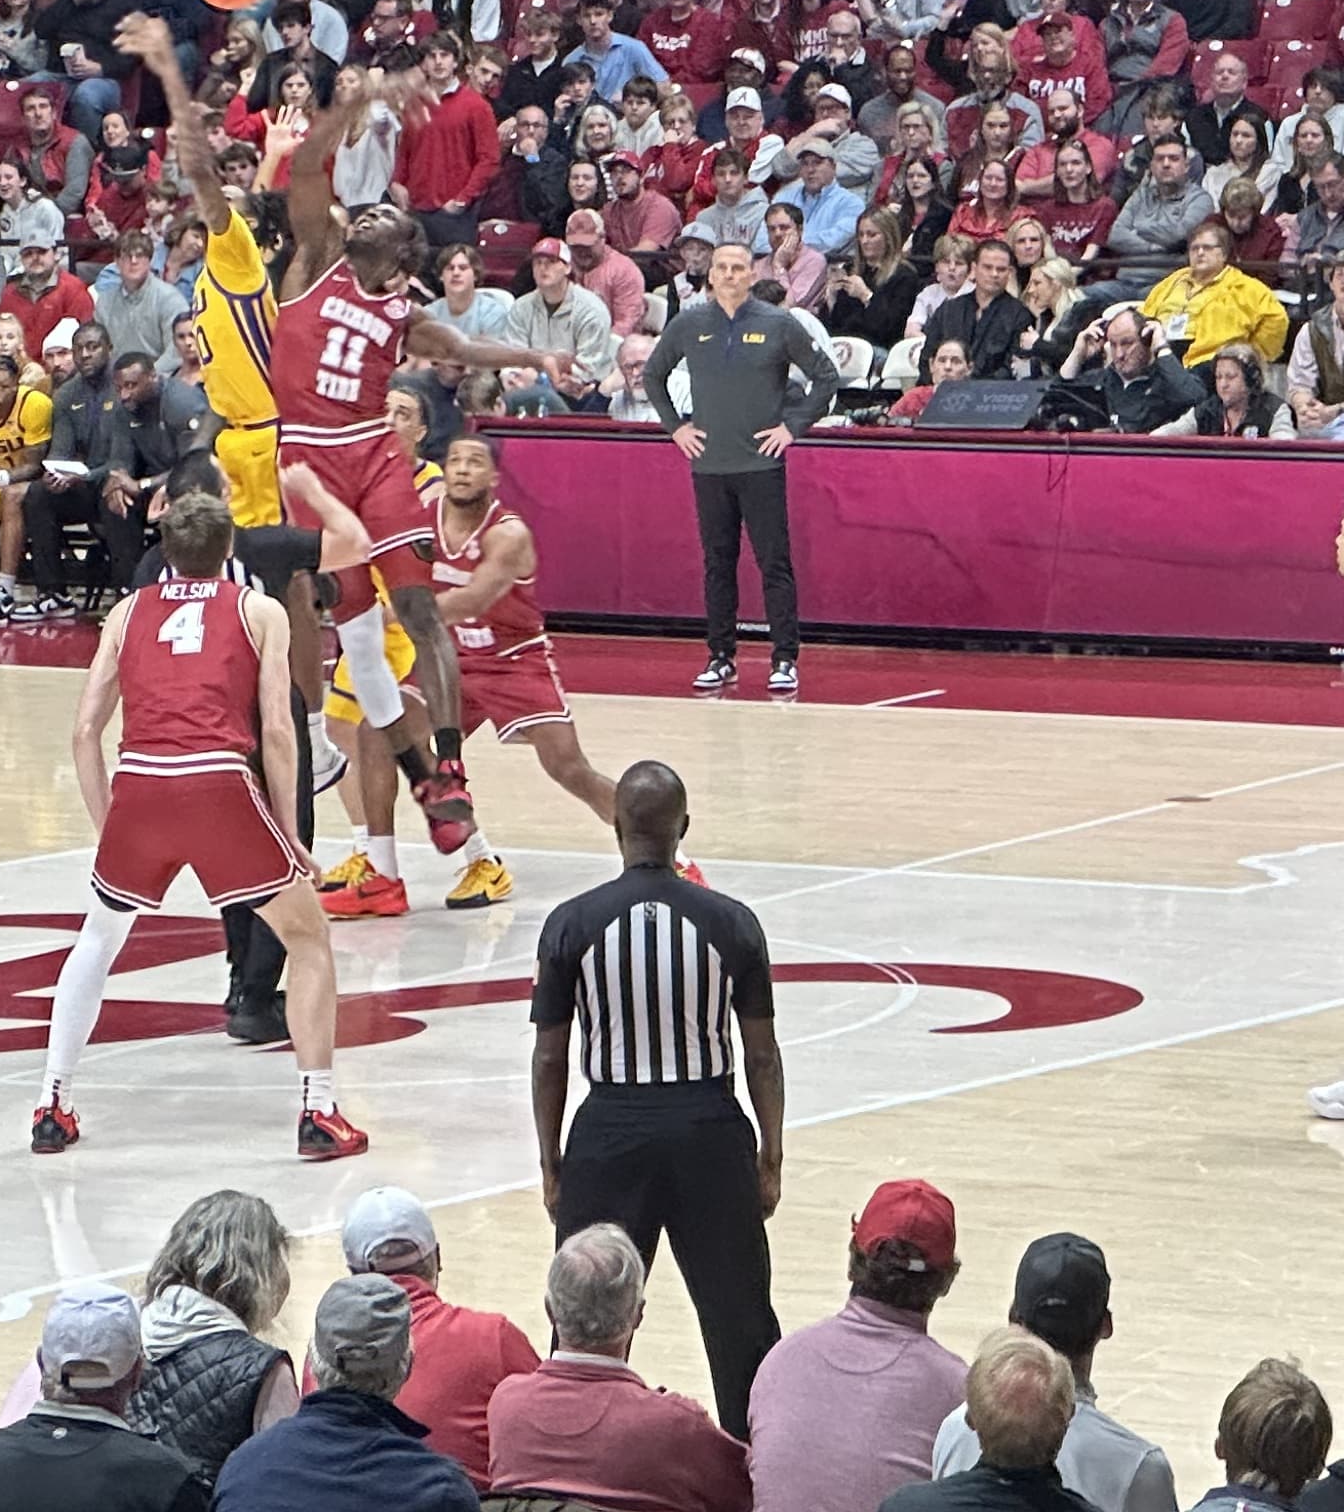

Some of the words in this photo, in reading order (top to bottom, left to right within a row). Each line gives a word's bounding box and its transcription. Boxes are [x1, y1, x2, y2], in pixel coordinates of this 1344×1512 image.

[1029, 76, 1086, 102] BAMA
[742, 333, 766, 344] LSU
[159, 581, 220, 600] NELSON
[157, 601, 205, 656] 4
